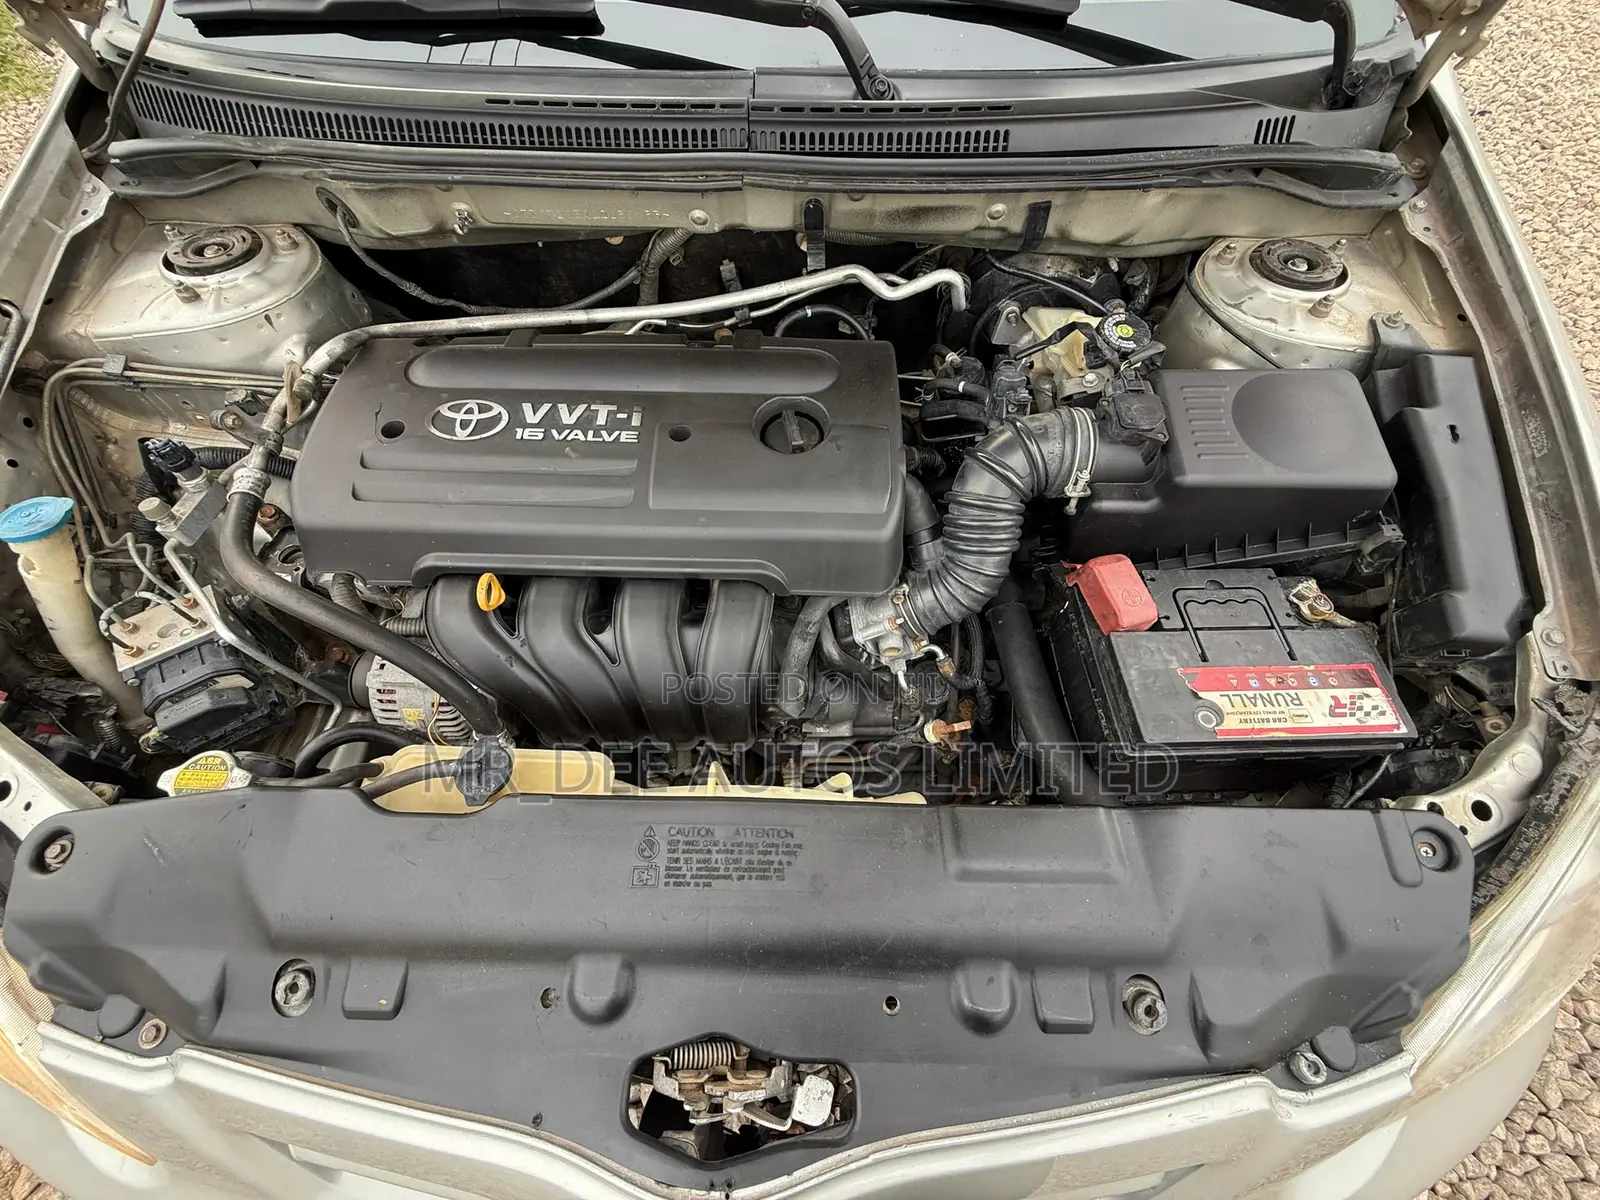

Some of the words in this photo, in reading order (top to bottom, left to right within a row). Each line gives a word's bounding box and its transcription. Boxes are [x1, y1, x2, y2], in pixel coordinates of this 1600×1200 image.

[521, 402, 645, 428] VVT-i
[514, 427, 546, 440] 16
[551, 428, 640, 443] VALVE
[1219, 692, 1304, 708] RUNALL
[188, 763, 227, 771] CAUTION
[668, 826, 715, 838] CAUTION
[733, 827, 795, 839] ATTENTION
[667, 839, 681, 847] KEEP
[703, 840, 720, 848] CLEAR
